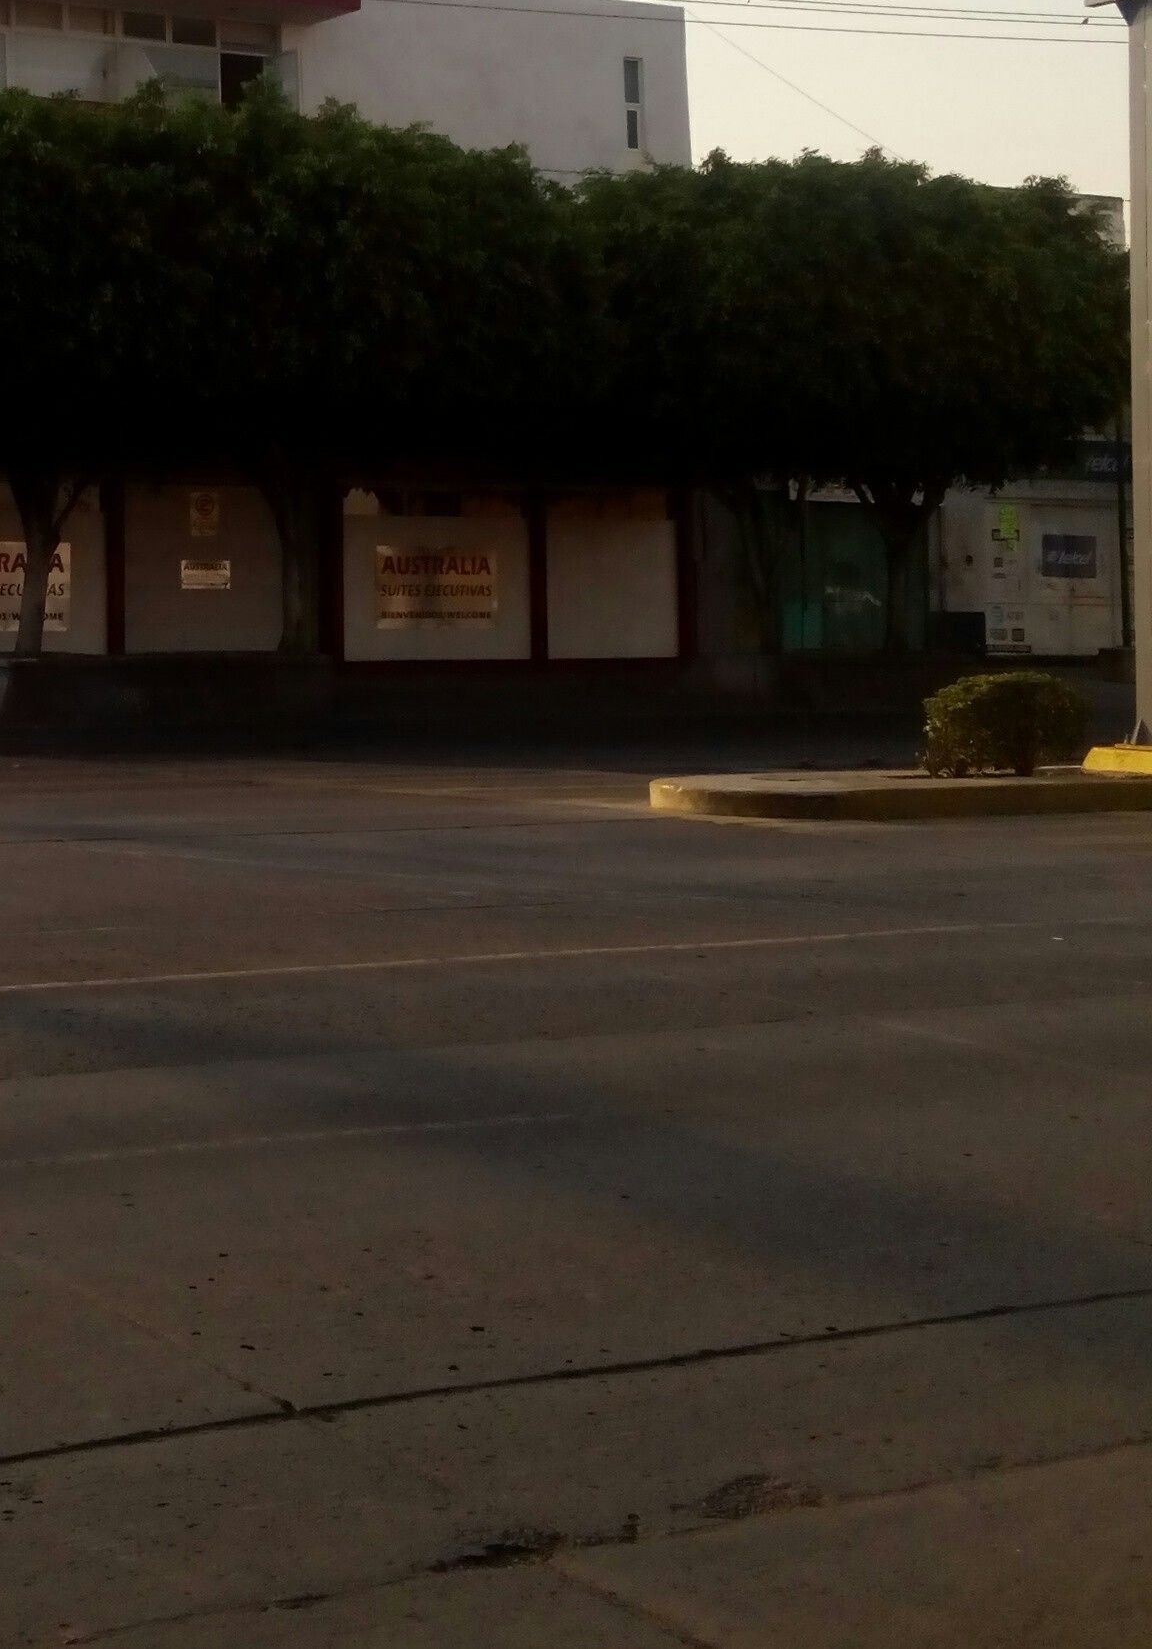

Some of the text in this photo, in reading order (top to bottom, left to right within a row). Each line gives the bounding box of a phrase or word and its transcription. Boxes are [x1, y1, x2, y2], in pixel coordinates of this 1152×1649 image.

[381, 556, 490, 575] AUSTRALIA
[381, 584, 492, 597] SUITES EJECUTIVAS
